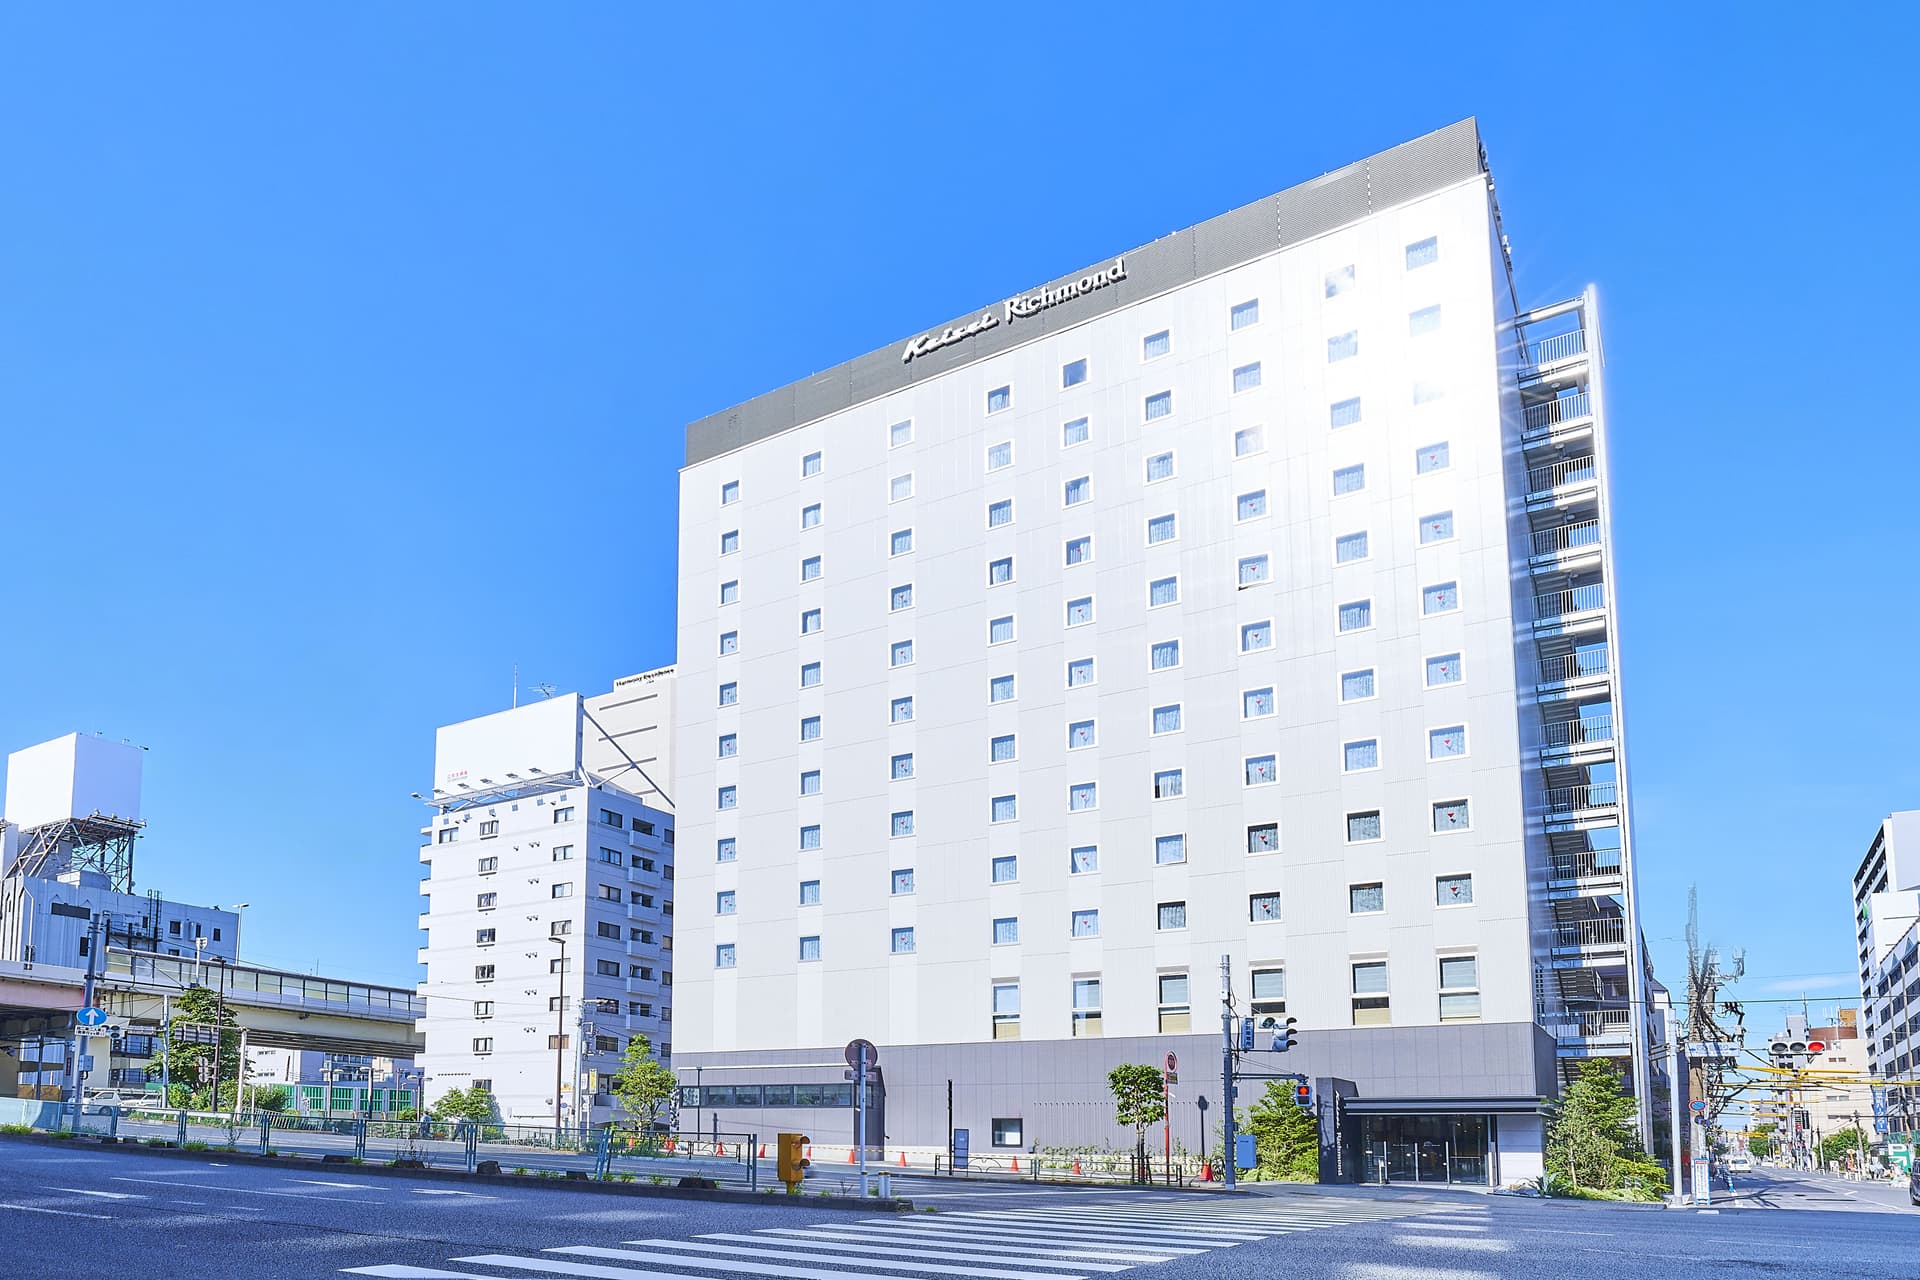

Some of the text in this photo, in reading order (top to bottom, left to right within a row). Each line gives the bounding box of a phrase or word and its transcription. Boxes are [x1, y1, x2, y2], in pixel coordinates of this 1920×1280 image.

[902, 257, 1128, 362] Keisei Richmond
[616, 668, 674, 686] Harmony Residence
